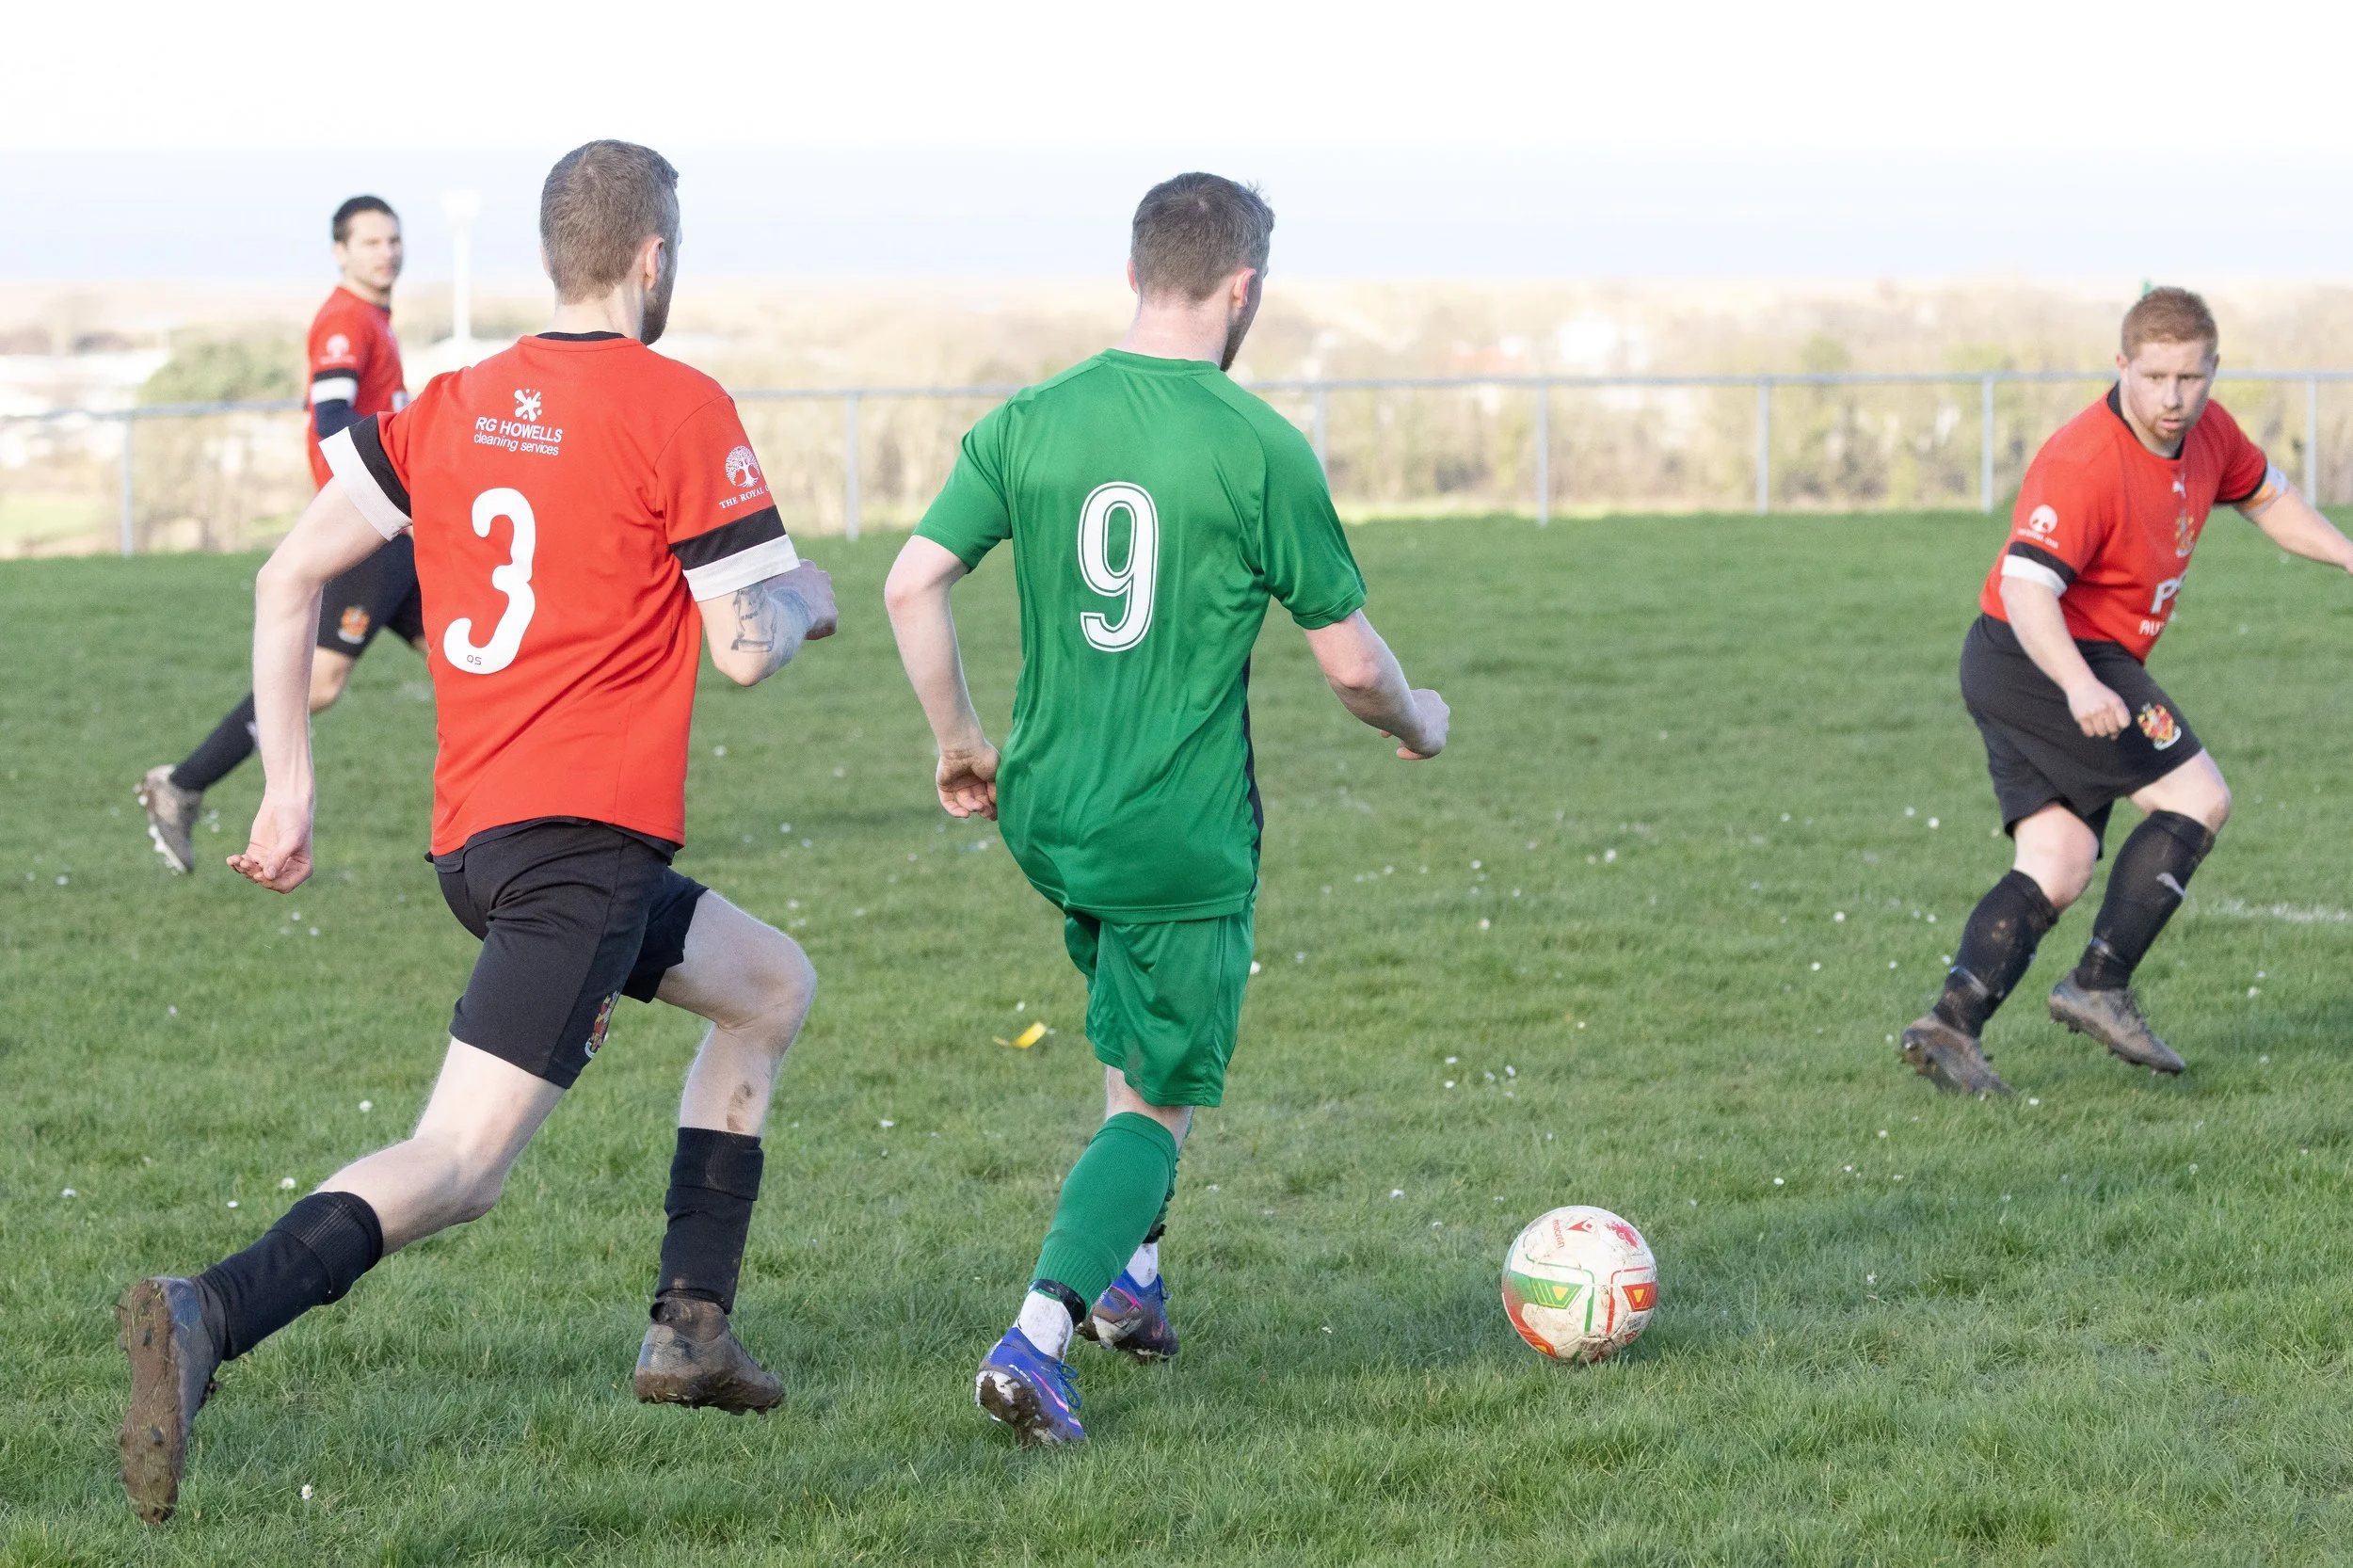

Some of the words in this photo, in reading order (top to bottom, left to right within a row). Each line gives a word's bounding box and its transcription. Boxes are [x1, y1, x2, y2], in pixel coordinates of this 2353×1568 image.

[473, 431, 519, 452] cleaning
[520, 441, 559, 456] services
[475, 416, 498, 432] RG
[499, 420, 563, 443] HOWELLS
[718, 496, 739, 509] THE
[739, 487, 764, 502] ROYAL
[1077, 481, 1160, 652] 9
[443, 488, 536, 674] 3
[1552, 1219, 1565, 1249] macron
